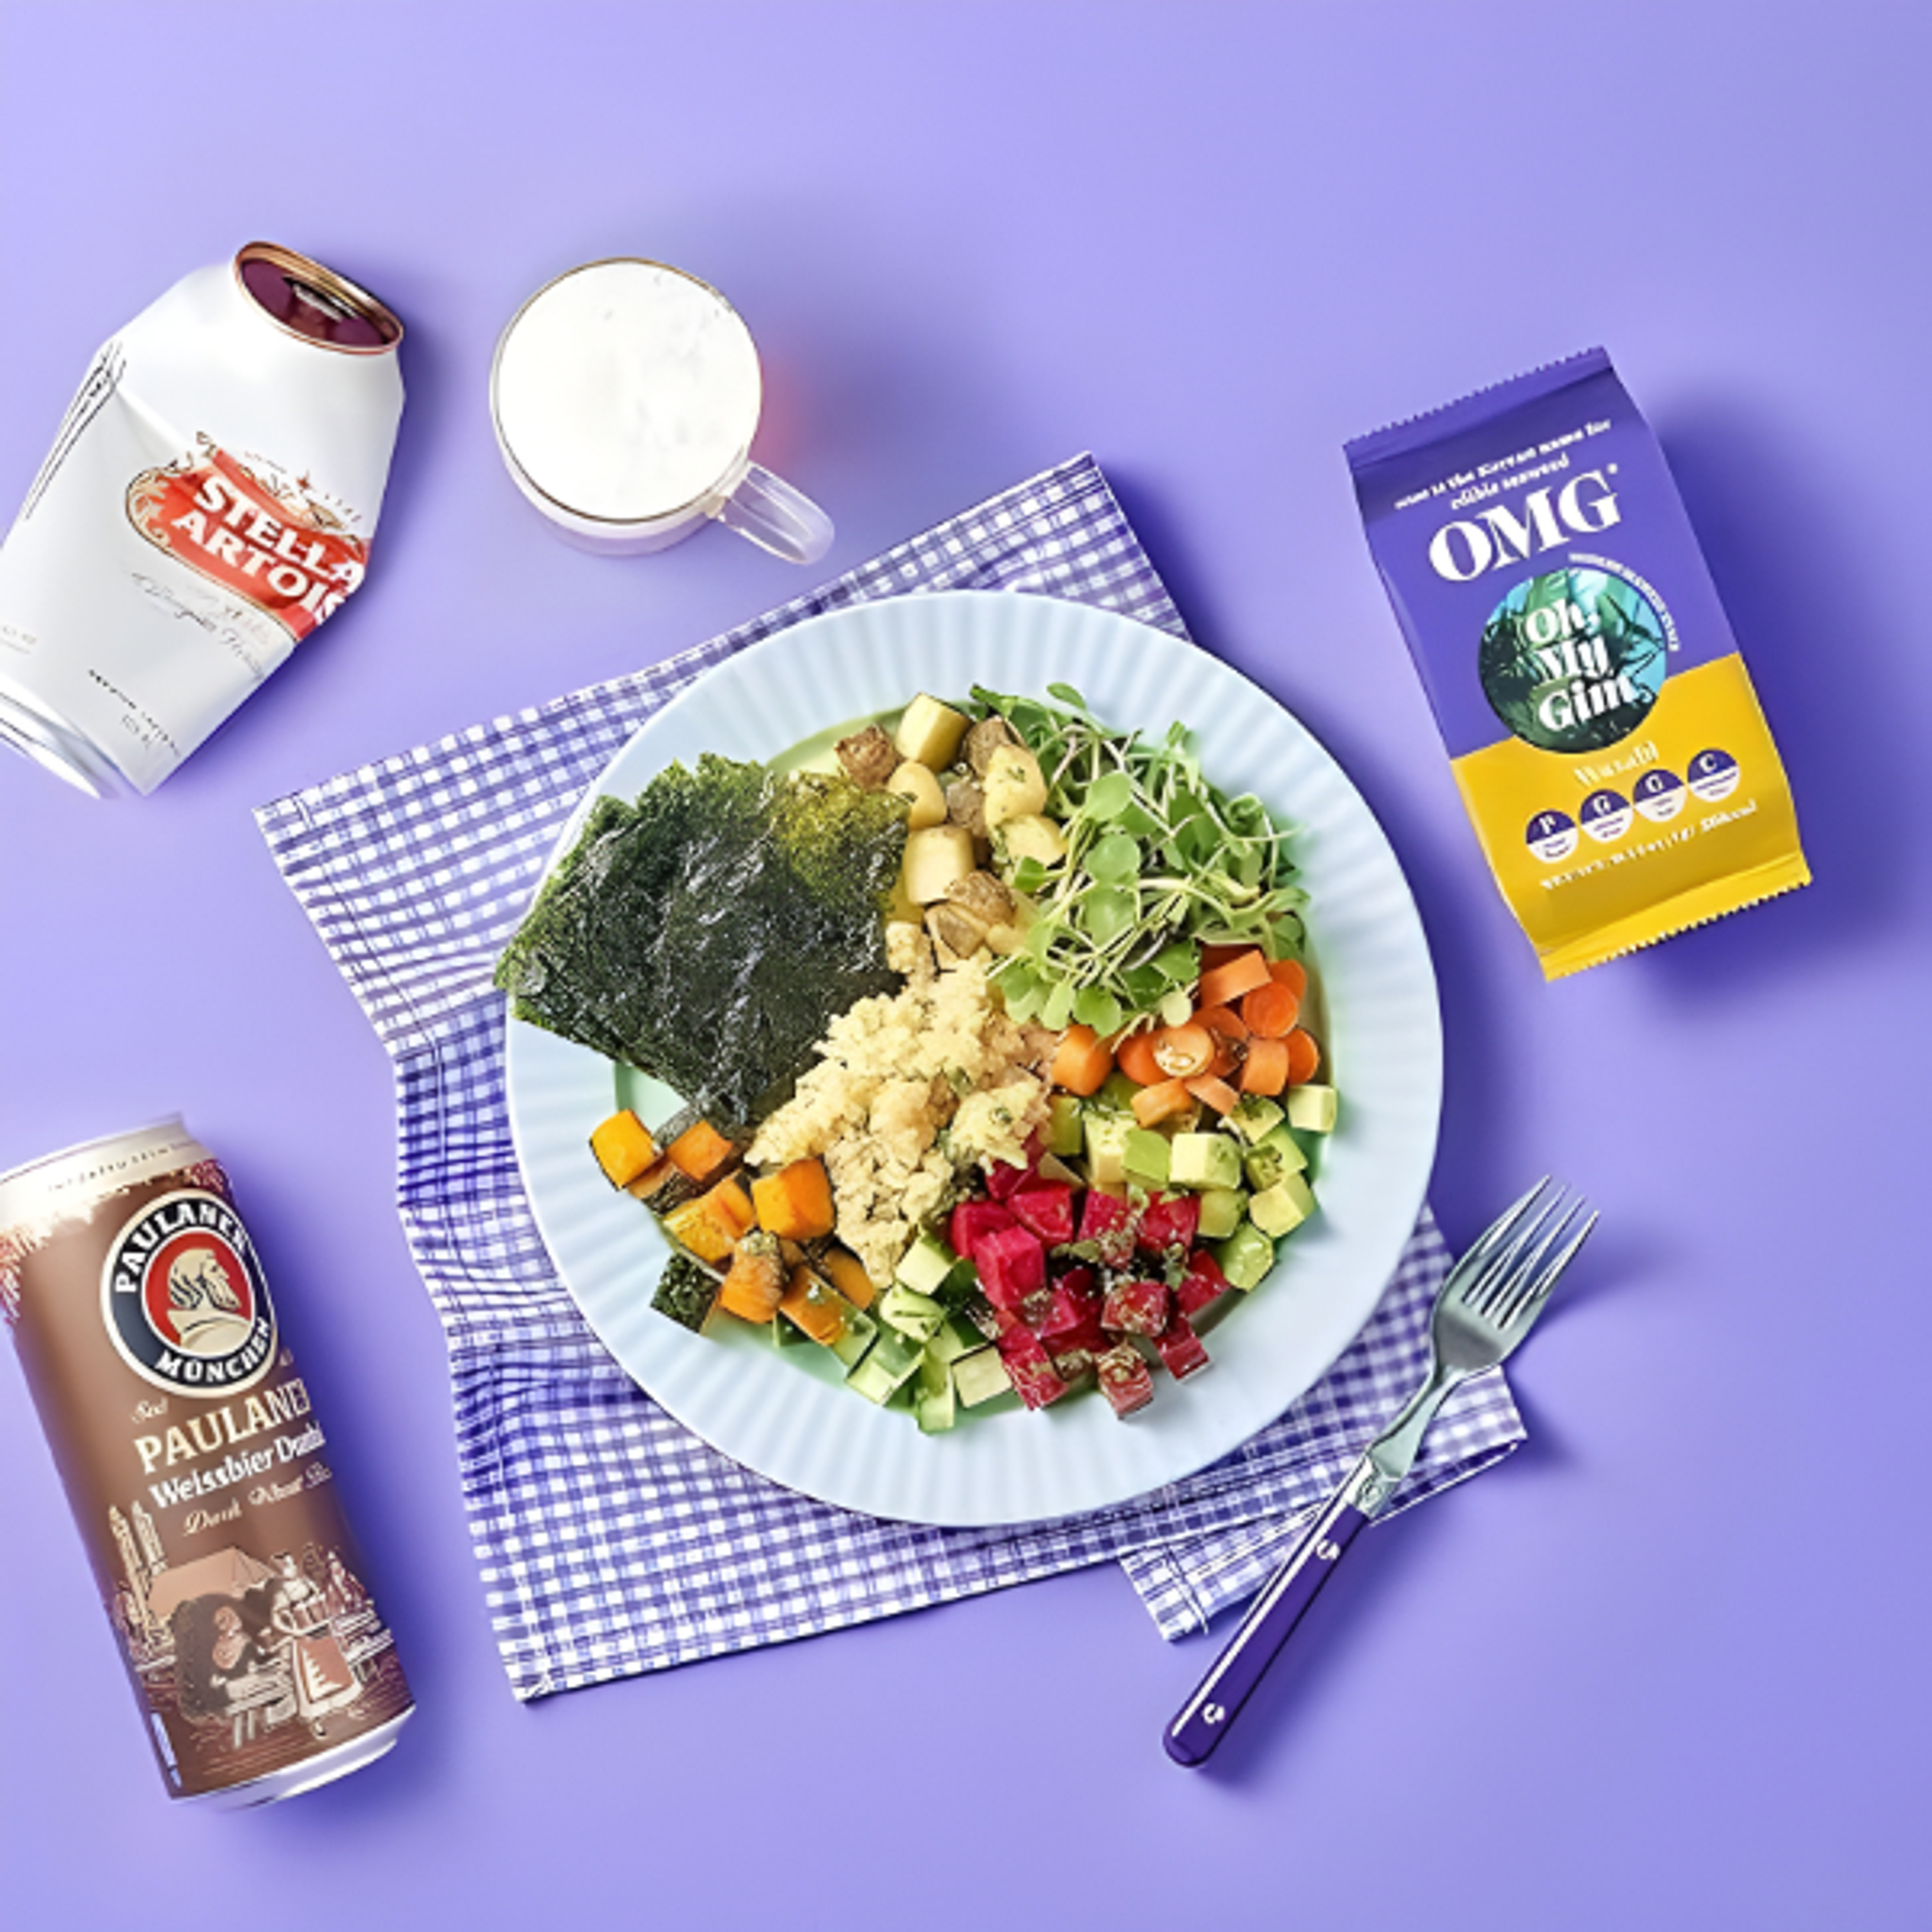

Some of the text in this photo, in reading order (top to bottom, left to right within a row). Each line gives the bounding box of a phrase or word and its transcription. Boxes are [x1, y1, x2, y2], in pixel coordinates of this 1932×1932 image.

[193, 475, 365, 594] STELLA
[1429, 469, 1621, 582] OMG
[1534, 634, 1611, 684] My
[115, 1202, 247, 1293] PAULANER
[148, 1448, 275, 1508] Weissbier
